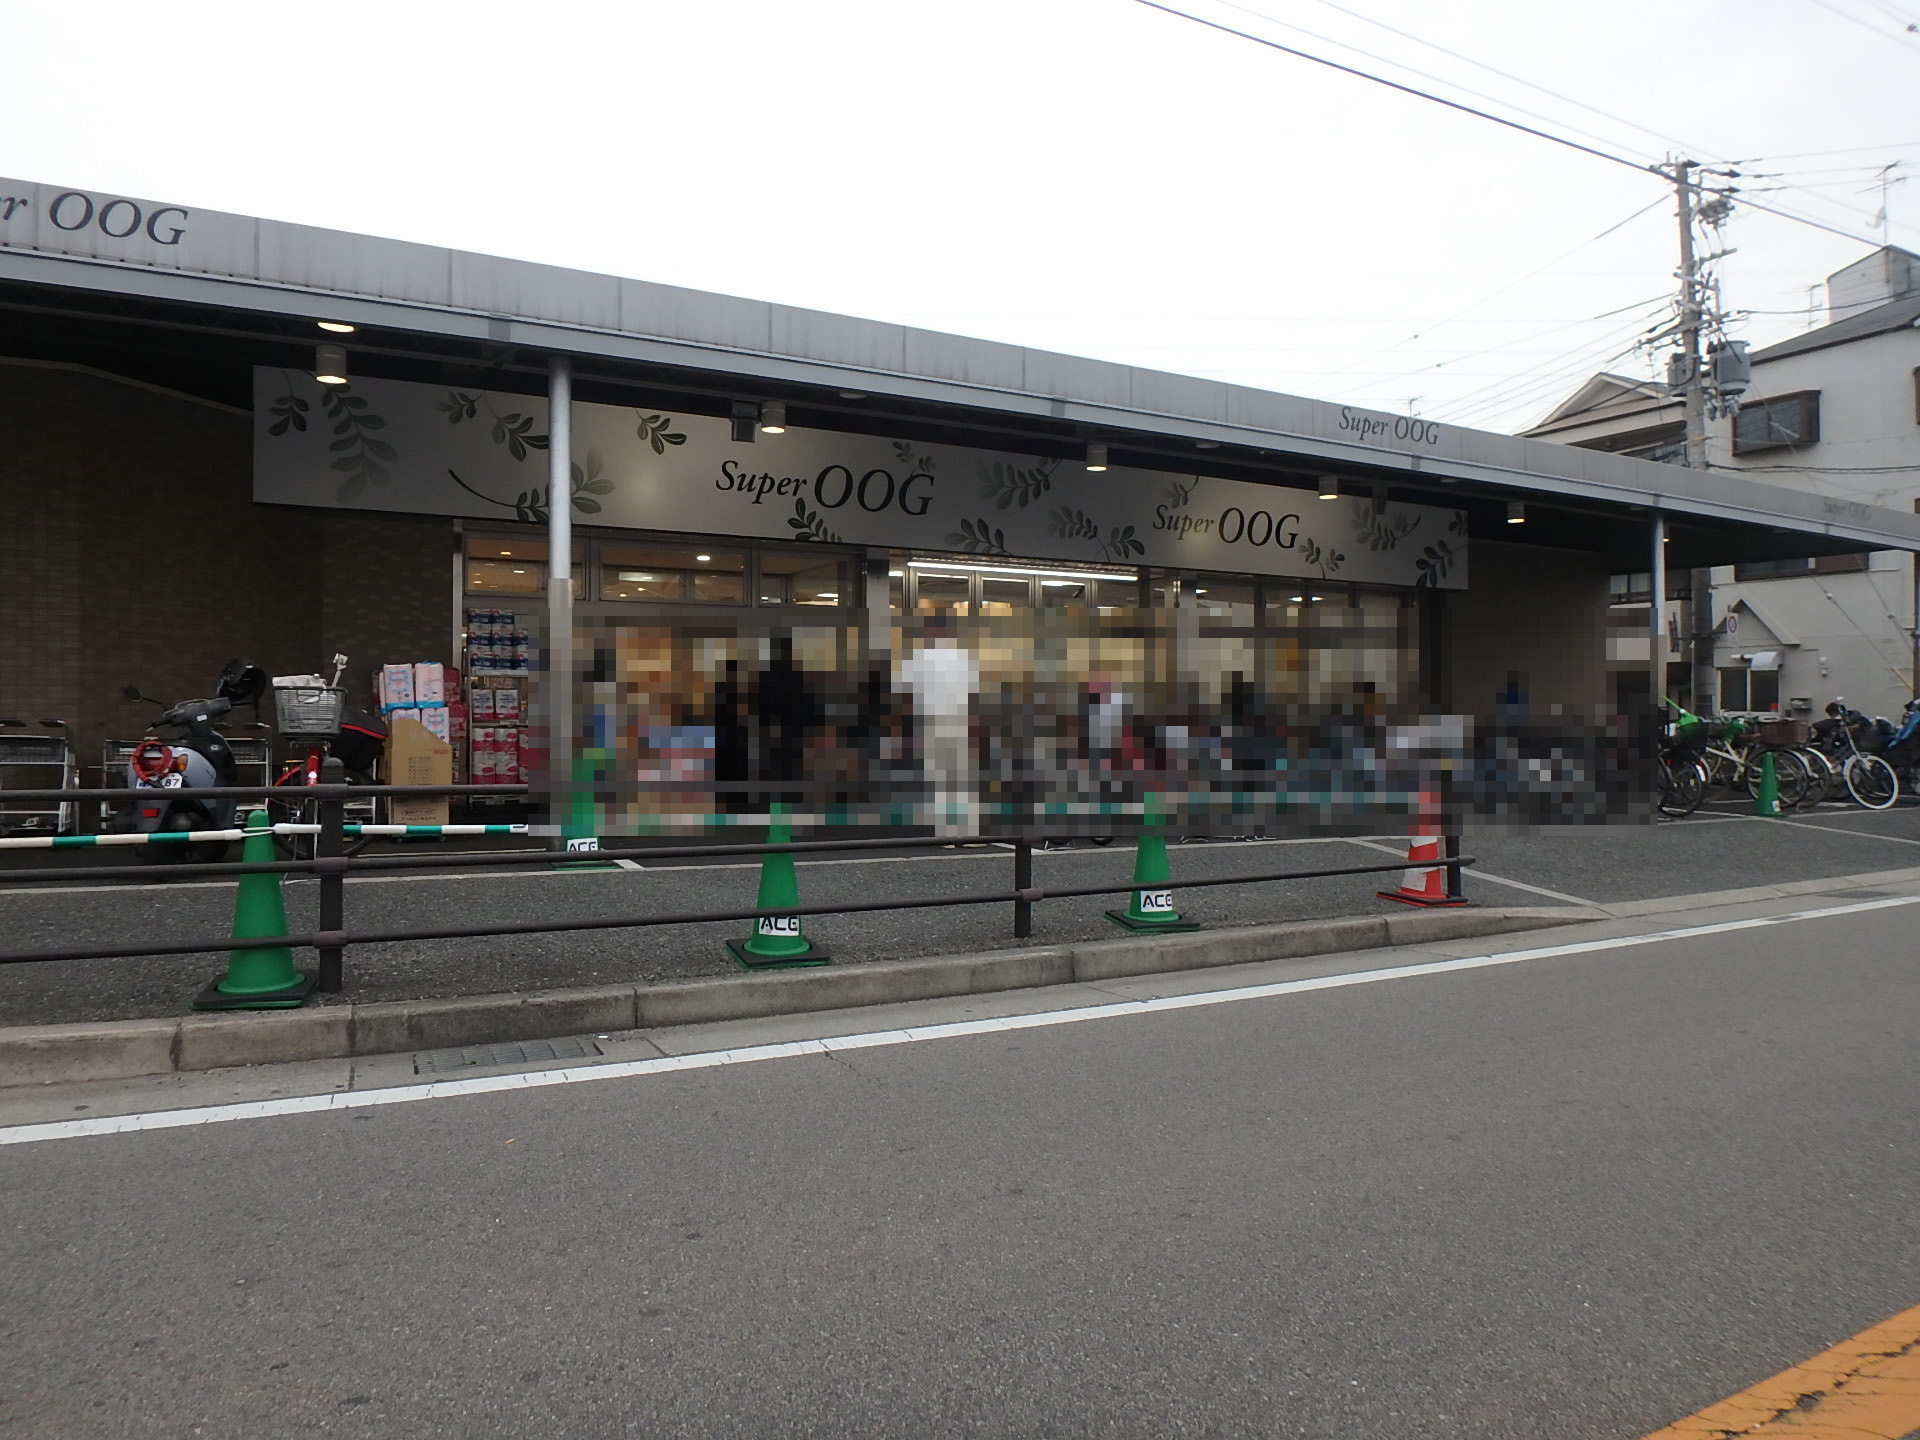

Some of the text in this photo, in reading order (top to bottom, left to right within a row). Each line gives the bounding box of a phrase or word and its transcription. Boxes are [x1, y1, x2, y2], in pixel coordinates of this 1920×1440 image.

[49, 192, 189, 245] OOG
[1338, 406, 1440, 445] Super OOG
[715, 460, 935, 516] Super OOG
[1152, 504, 1300, 549] Super OOG
[1142, 893, 1172, 908] ACE
[760, 914, 798, 932] ACE
